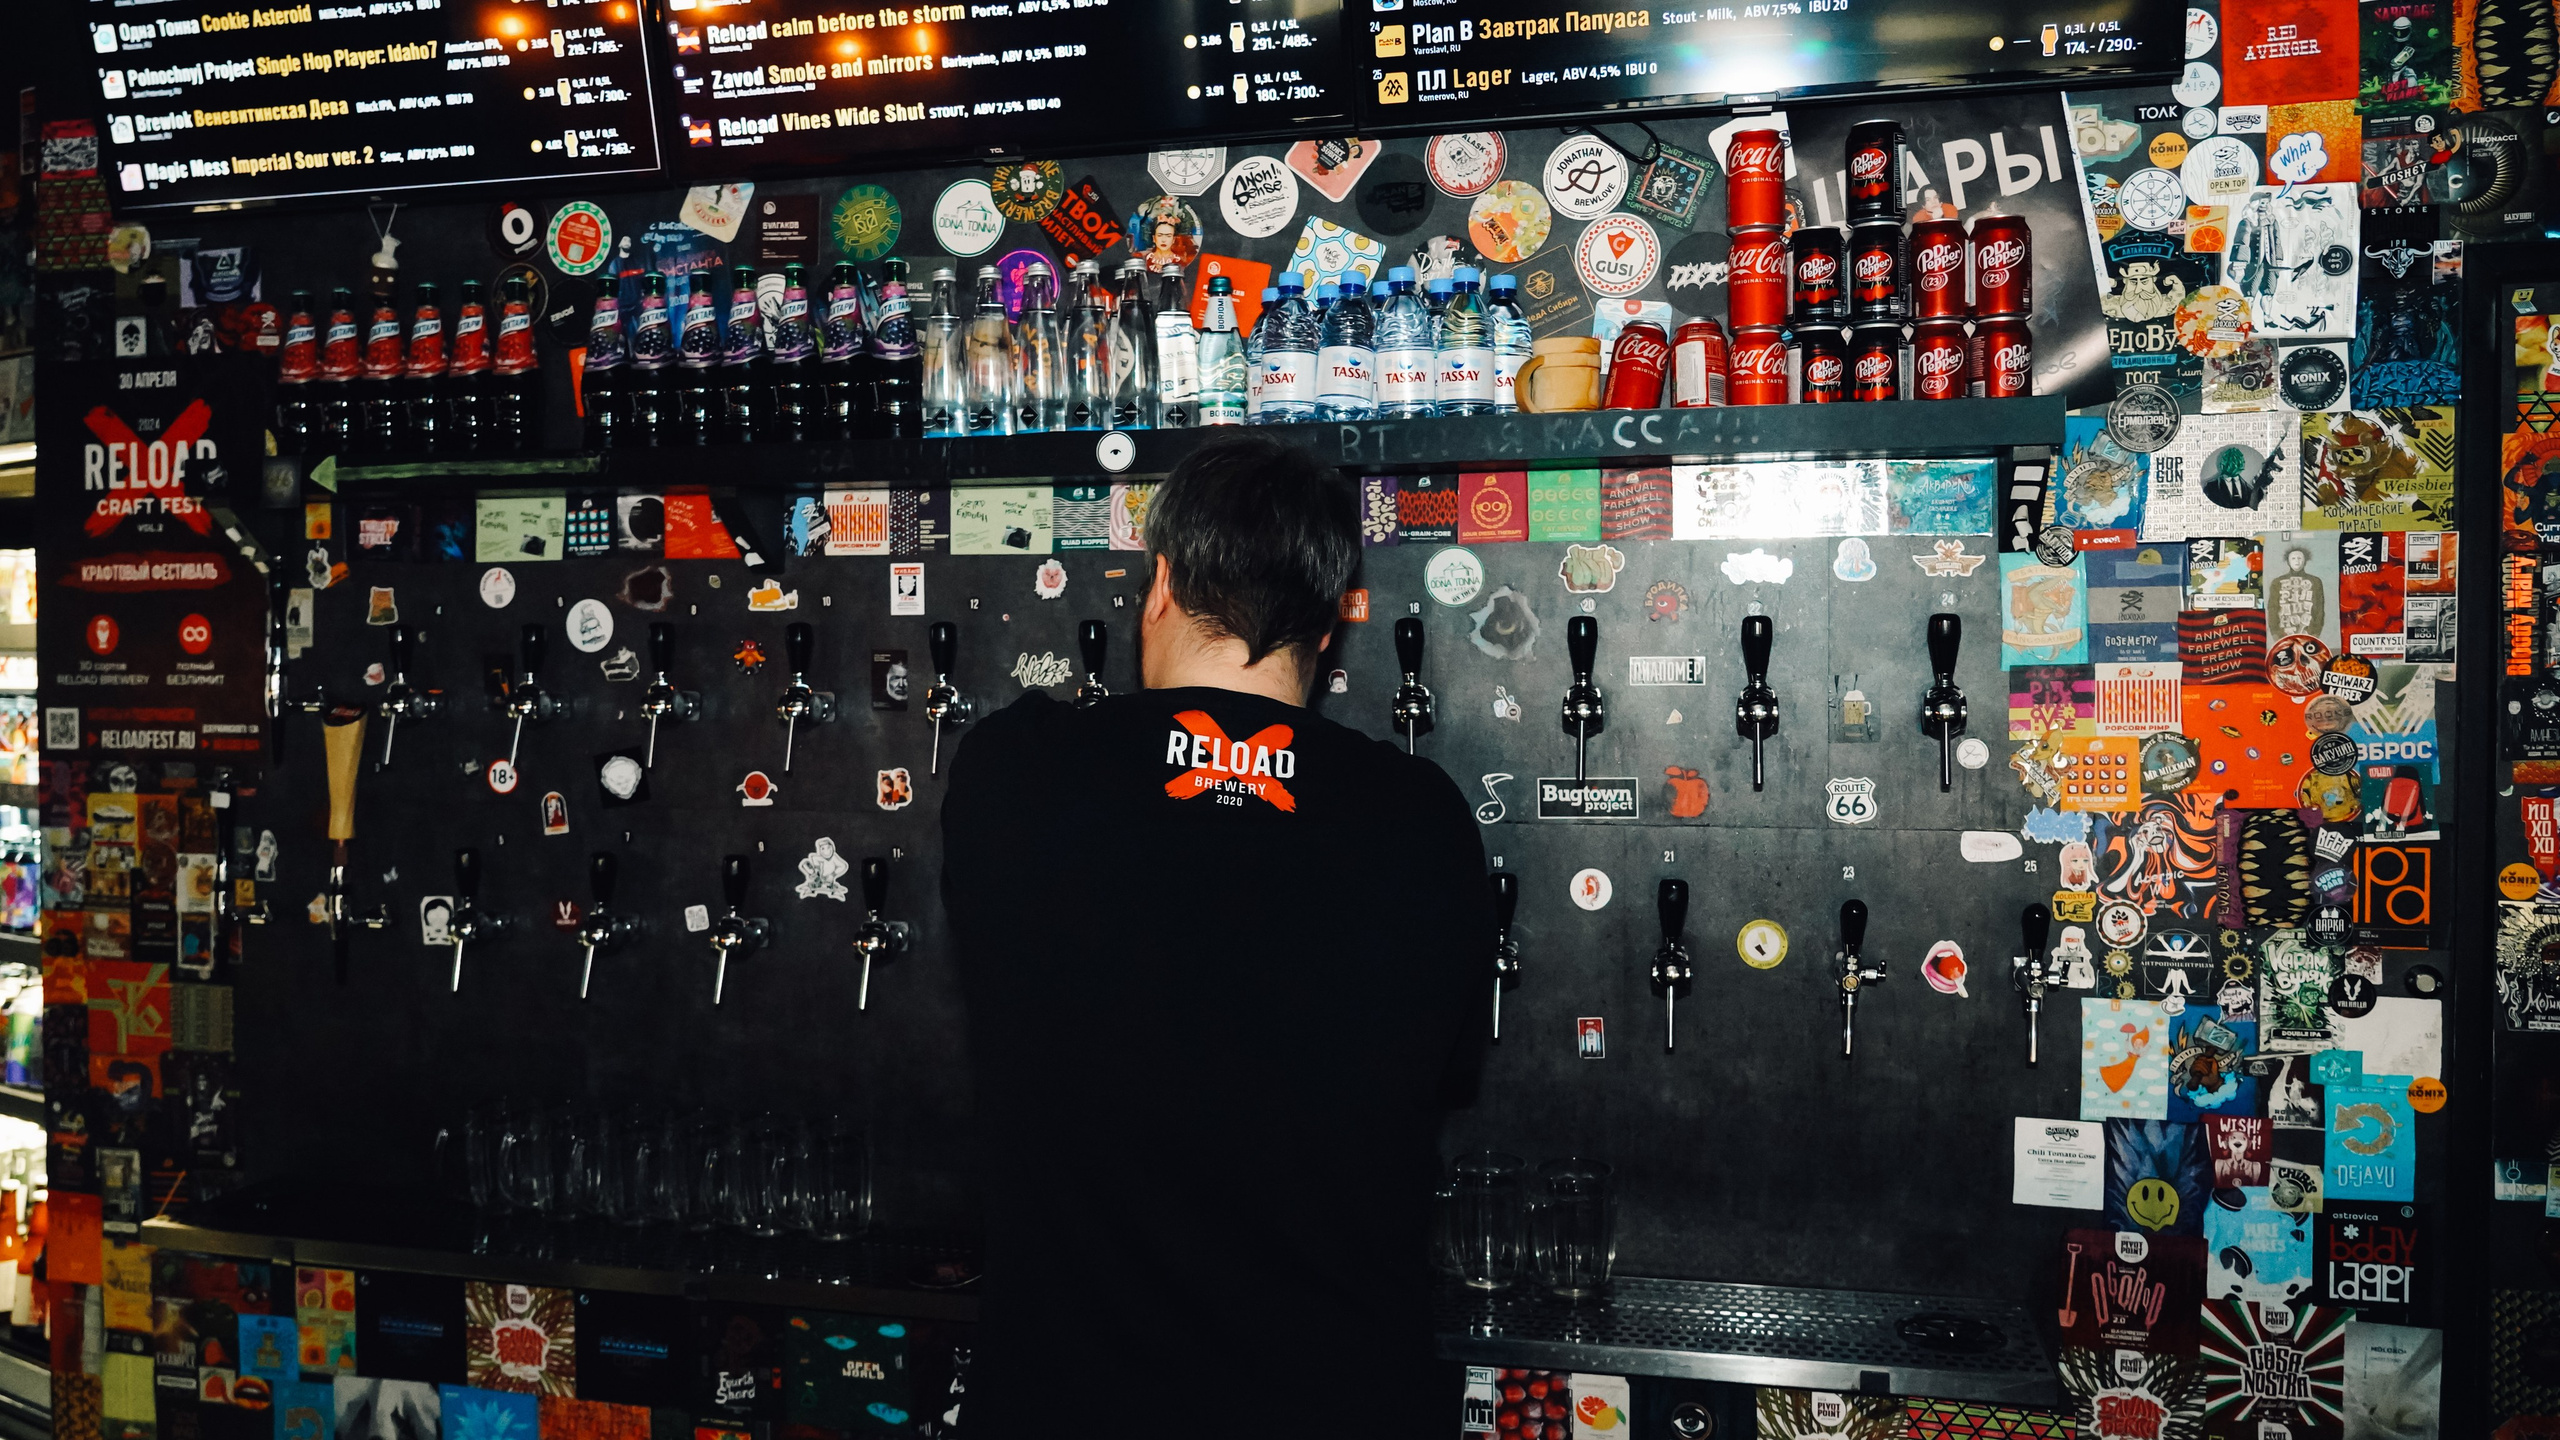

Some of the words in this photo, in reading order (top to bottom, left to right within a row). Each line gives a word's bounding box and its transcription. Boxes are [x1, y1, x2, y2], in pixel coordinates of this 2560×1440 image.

[118, 23, 156, 43] Одна
[156, 19, 200, 37] Тонна
[201, 14, 250, 33] Cookie
[252, 4, 312, 28] Asteroid
[707, 21, 768, 45] Reload
[771, 17, 814, 39] calm
[818, 12, 876, 34] before
[879, 7, 909, 28] the
[912, 4, 966, 25] storm
[971, 4, 1012, 18] Porter,
[1369, 22, 1380, 33] 24
[1413, 22, 1454, 45] Plan
[1460, 20, 1473, 41] B
[1479, 17, 1560, 41] Завтрак
[1566, 10, 1650, 38] Папуаса
[1662, 11, 1697, 25] Stout
[1707, 7, 1737, 22] Milk,
[1744, 3, 1771, 18] ABV
[1772, 2, 1801, 17] 7,5%
[1808, 0, 1832, 13] IBU
[1833, 0, 1848, 12] 20
[2064, 24, 2086, 35] 0,3L
[2098, 21, 2120, 33] 0,5L
[2267, 25, 2298, 42] RED
[1413, 44, 1448, 55] Yaroslavl,
[1450, 44, 1461, 53] RU
[2244, 39, 2322, 61] AVENGER
[203, 58, 256, 82] Project
[256, 55, 301, 77] Single
[303, 52, 333, 72] Hop
[334, 48, 386, 68] Player:
[388, 40, 438, 62] Idaho7
[711, 66, 765, 91] Zavod
[768, 62, 826, 85] Smoke
[831, 57, 863, 79] and
[867, 53, 934, 76] mirrors
[1372, 69, 1383, 81] 25
[1417, 69, 1447, 91] ПЛ
[1453, 66, 1512, 91] Lager
[1521, 69, 1558, 85] Lager,
[1562, 67, 1588, 80] ABV
[1589, 65, 1621, 80] 4,5%
[1625, 62, 1647, 77] IBU
[1650, 62, 1658, 75] 0
[1418, 93, 1456, 103] Kemerovo,
[1458, 90, 1469, 100] RU
[135, 111, 193, 133] Brewlok
[194, 103, 308, 128] Веневитинская
[309, 98, 349, 121] Дева
[718, 114, 779, 138] Reload
[782, 110, 831, 132] Vines
[835, 106, 880, 128] Wide
[884, 102, 926, 124] Shut
[929, 105, 969, 120] STOUT,
[1322, 147, 1346, 164] SUBITE
[1326, 141, 1346, 156] MORT
[144, 160, 188, 183] Magic
[190, 158, 230, 178] Mess
[231, 152, 292, 176] Imperial
[294, 150, 329, 169] Sour
[332, 149, 361, 166] ver.
[363, 145, 375, 164] 2
[1556, 147, 1604, 176] JONATHAN
[1852, 155, 1888, 176] Pepper
[1861, 151, 1875, 164] Dr
[2381, 163, 2427, 186] KOSHEY
[2210, 179, 2231, 191] OPEN
[2231, 178, 2247, 189] TOP
[1574, 182, 1617, 207] BREWLOVE
[1061, 188, 1123, 248] ТВОЙ
[2371, 205, 2428, 215] STONE
[938, 216, 964, 231] ODNA
[967, 219, 998, 233] TONNA
[1596, 260, 1634, 278] GUSI
[1763, 277, 1783, 285] TASTE
[1926, 275, 1940, 287] 23
[1547, 294, 1580, 316] Сибири
[1217, 297, 1225, 331] BORJOMI
[119, 373, 133, 389] 30
[1332, 366, 1372, 383] TASSAY
[1385, 371, 1428, 384] TASSAY
[1440, 370, 1480, 383] TASSAY
[2125, 371, 2161, 385] ГОСТ
[2291, 371, 2331, 385] KONIX
[2156, 456, 2183, 470] HOP
[2156, 469, 2183, 483] GUN
[2383, 478, 2454, 493] Weissbier
[97, 498, 155, 515] CRAFT
[161, 497, 203, 514] FEST
[2323, 501, 2404, 518] КОСМИЧЕСКИЕ
[1615, 516, 1651, 532] SHOW
[2338, 518, 2382, 531] ПИРАТЫ
[1430, 577, 1452, 589] ODNA
[1455, 576, 1481, 587] TONNA
[823, 596, 832, 607] 10
[970, 598, 979, 610] 12
[1113, 596, 1124, 608] 14
[1582, 600, 1594, 611] 20
[1941, 593, 1954, 606] 24
[1409, 602, 1420, 614] 18
[2194, 624, 2249, 642] ANNUAL
[2188, 635, 2256, 654] FAREWELL
[2201, 648, 2243, 665] FREAK
[2202, 660, 2242, 676] SHOW
[2325, 672, 2373, 692] SCHWARZ
[2328, 685, 2362, 702] KAISER
[2105, 724, 2147, 732] POPCORN
[101, 730, 196, 750] RELOADFEST.RU
[1166, 730, 1295, 779] RELOAD
[1194, 775, 1268, 796] BREWERY
[1834, 783, 1866, 793] ROUTE
[1216, 794, 1243, 807] 2020
[1542, 784, 1633, 807] Bugtown
[1585, 800, 1633, 813] project
[1835, 795, 1867, 816] 66
[2316, 827, 2353, 851] BEER
[1492, 856, 1503, 868] 19
[1664, 850, 1675, 863] 21
[2024, 860, 2037, 873] 25
[2134, 868, 2185, 887] Acerbic
[2150, 881, 2170, 897] Wit
[2281, 1030, 2305, 1038] DOUBLE
[2306, 1030, 2322, 1038] IPA
[2220, 1118, 2261, 1133] WISH!
[2333, 1212, 2378, 1221] ostrovica
[2265, 1311, 2288, 1320] PIVOT
[2265, 1318, 2288, 1327] POINT
[2250, 1347, 2303, 1374] COSA
[2243, 1373, 2311, 1399] NOSTRA
